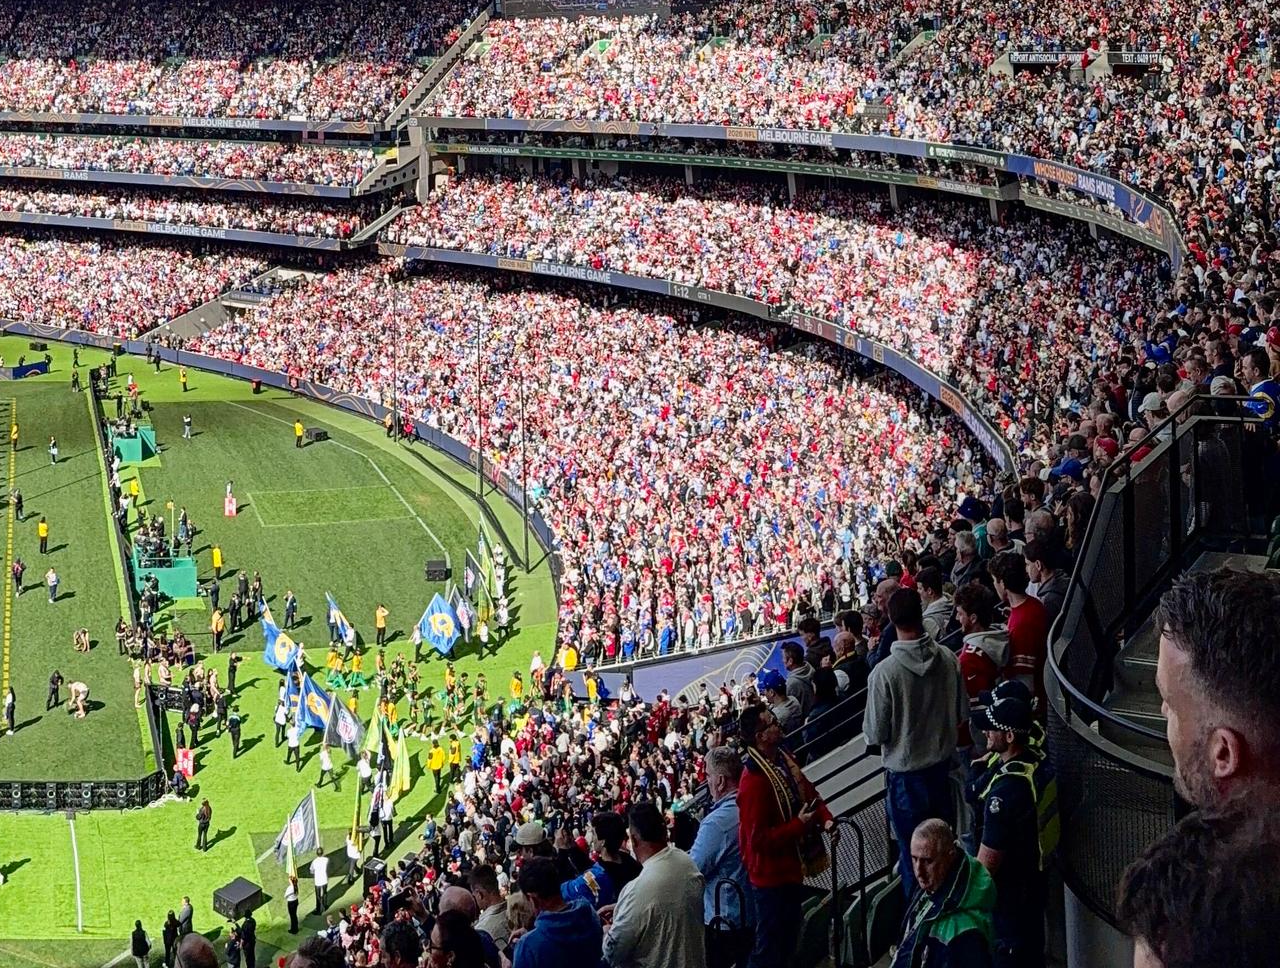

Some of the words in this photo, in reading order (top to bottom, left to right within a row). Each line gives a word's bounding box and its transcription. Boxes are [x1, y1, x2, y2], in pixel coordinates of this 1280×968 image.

[183, 118, 234, 128] MELBOURNE
[235, 120, 260, 129] GAME
[758, 130, 809, 143] MELBOURNE
[810, 134, 832, 146] GAME
[468, 145, 502, 153] MELBOURNE
[63, 172, 88, 180] RAMS
[1034, 161, 1055, 179] WHOSE
[1056, 167, 1077, 186] HOUSE?
[1078, 173, 1095, 194] RAMS
[1096, 179, 1115, 201] HOUSE
[148, 223, 200, 237] MELBOURNE
[201, 229, 226, 238] GAME
[517, 261, 530, 270] NFL
[532, 262, 586, 279] MELBOURNE
[587, 270, 611, 283] GAME
[673, 286, 689, 299] 1:12
